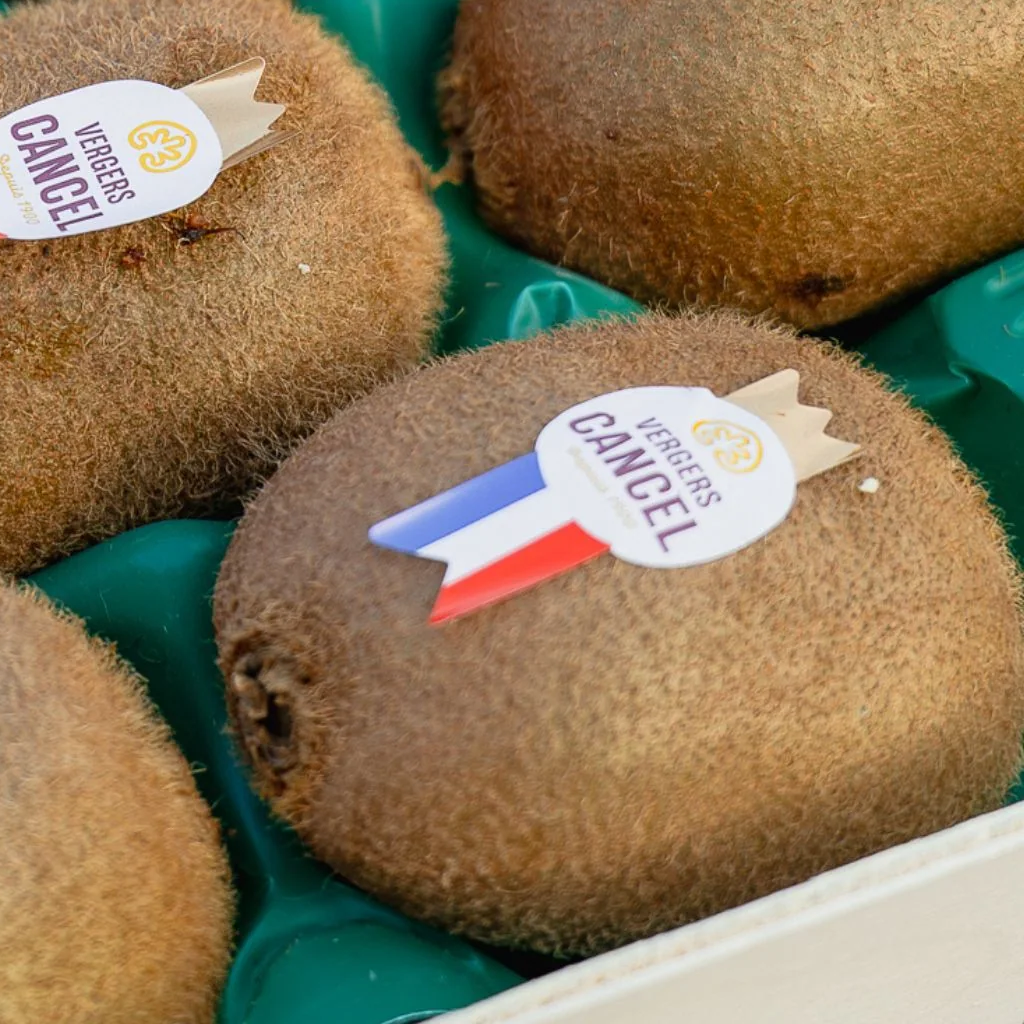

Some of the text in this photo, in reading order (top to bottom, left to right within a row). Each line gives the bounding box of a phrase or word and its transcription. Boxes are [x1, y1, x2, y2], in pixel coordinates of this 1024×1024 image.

[10, 113, 104, 232] CANCEL
[74, 120, 136, 206] VERGERS
[568, 411, 698, 553] CANCEL
[635, 416, 722, 509] VERGERS
